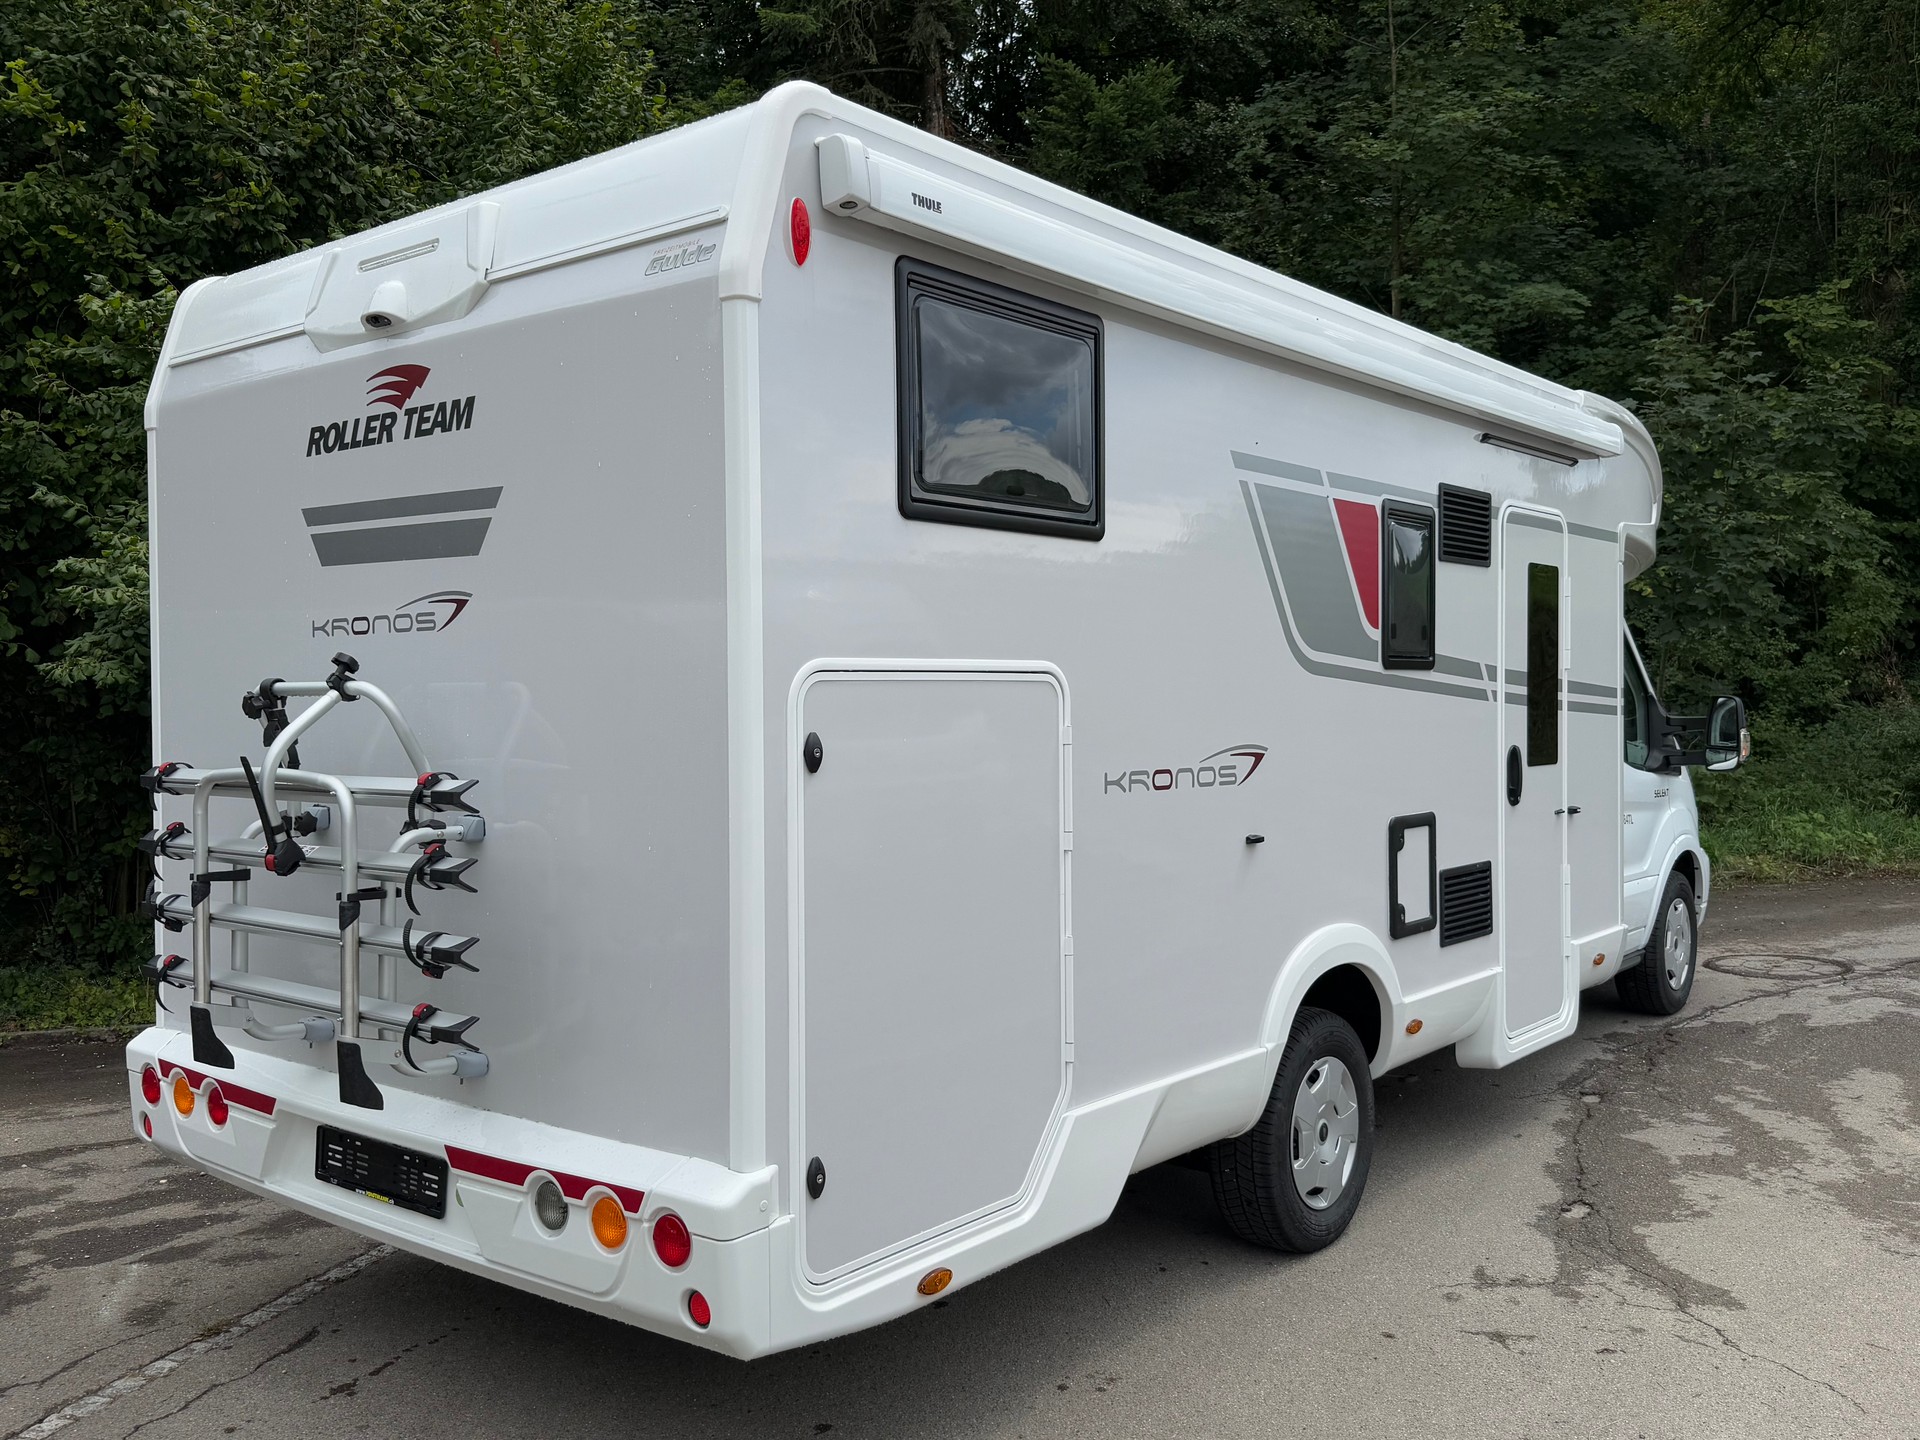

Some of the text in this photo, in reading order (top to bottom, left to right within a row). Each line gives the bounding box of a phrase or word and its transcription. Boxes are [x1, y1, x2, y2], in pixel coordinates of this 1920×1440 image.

[911, 191, 943, 215] THULE
[306, 395, 476, 458] ROLLER TEAM
[312, 611, 437, 638] KRONOS
[1104, 764, 1238, 795] KRONOS
